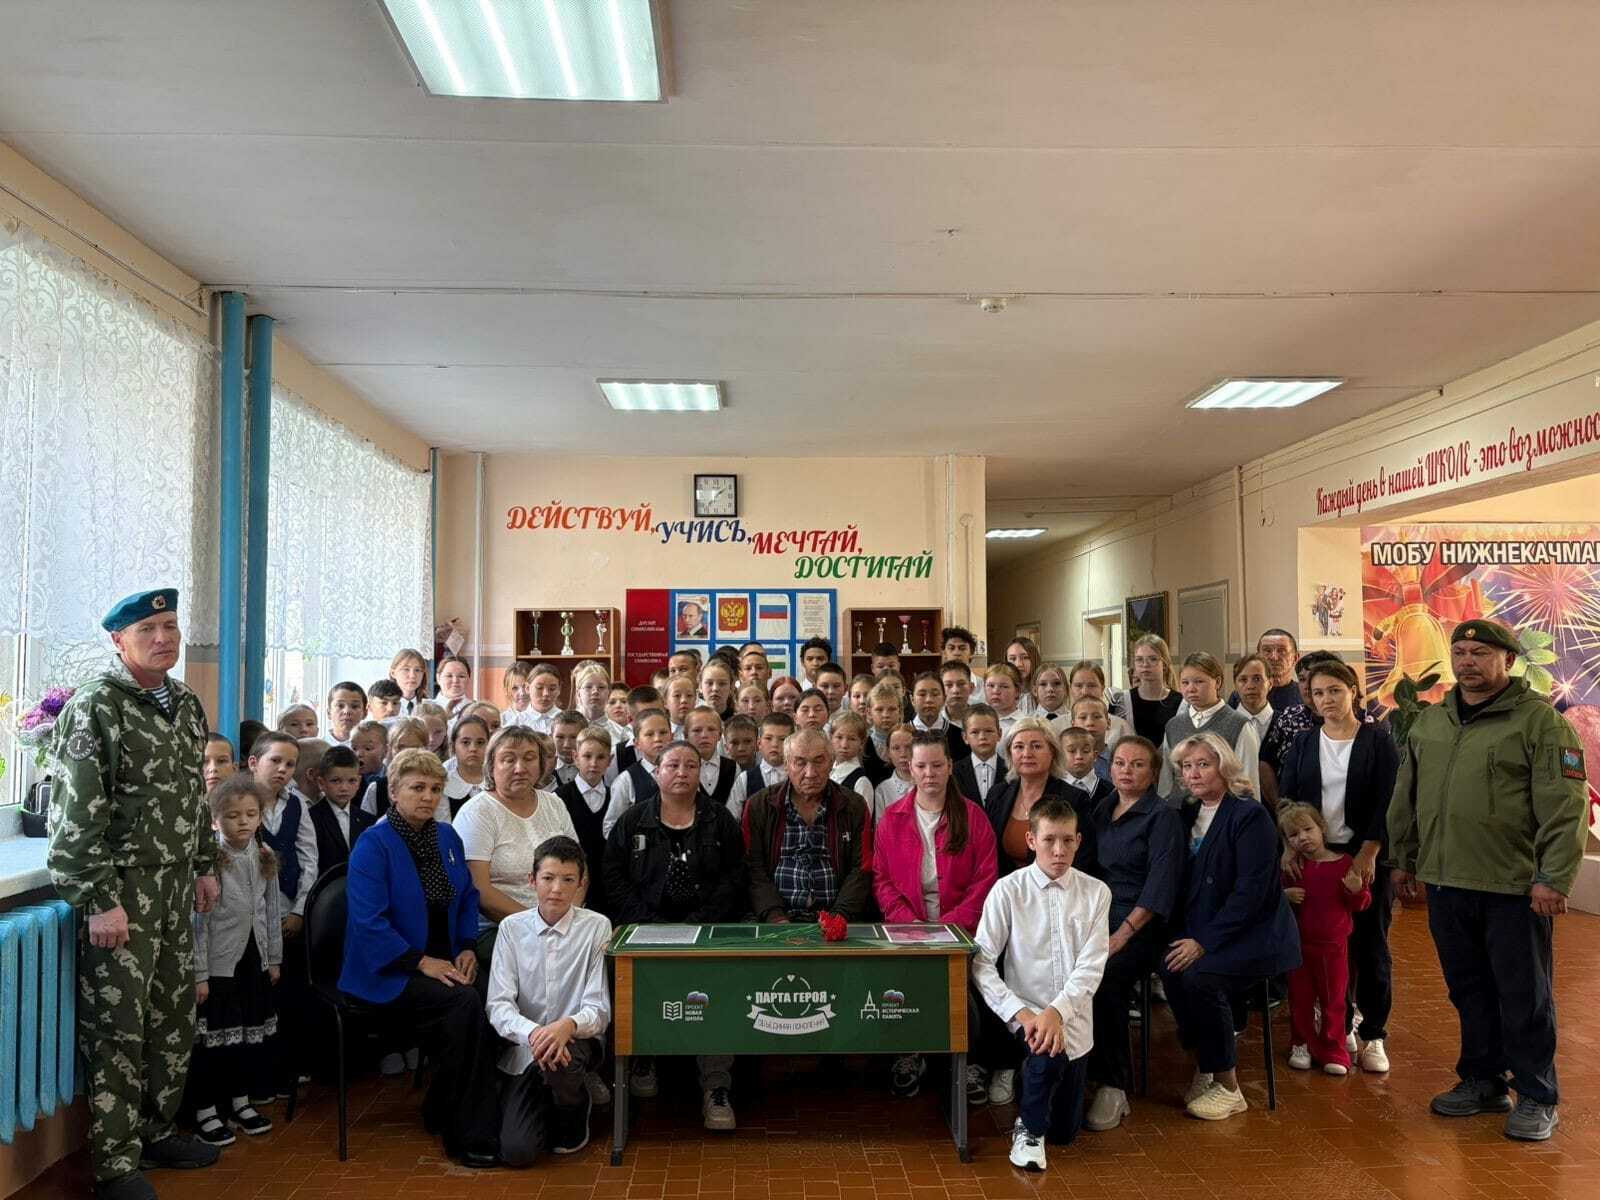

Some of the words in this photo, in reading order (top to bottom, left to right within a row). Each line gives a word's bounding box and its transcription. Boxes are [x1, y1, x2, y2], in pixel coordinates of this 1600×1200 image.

[1315, 478, 1355, 518] Каждый
[1356, 478, 1378, 514] день
[1380, 466, 1387, 497] в
[1388, 456, 1425, 497] нашей
[1425, 440, 1471, 486] ШКОЛЕ
[1479, 441, 1508, 472] это
[506, 500, 655, 535] ДЕЙСТВУЙ,
[654, 518, 752, 545] УЧИСЬ,
[752, 524, 863, 556] МЕЧТАЙ,
[794, 550, 934, 581] ДОСТИГАЙ
[1371, 542, 1435, 566] МОБУ
[755, 991, 791, 1004] ПАРТА
[793, 991, 828, 1003] ГЕРОЯ
